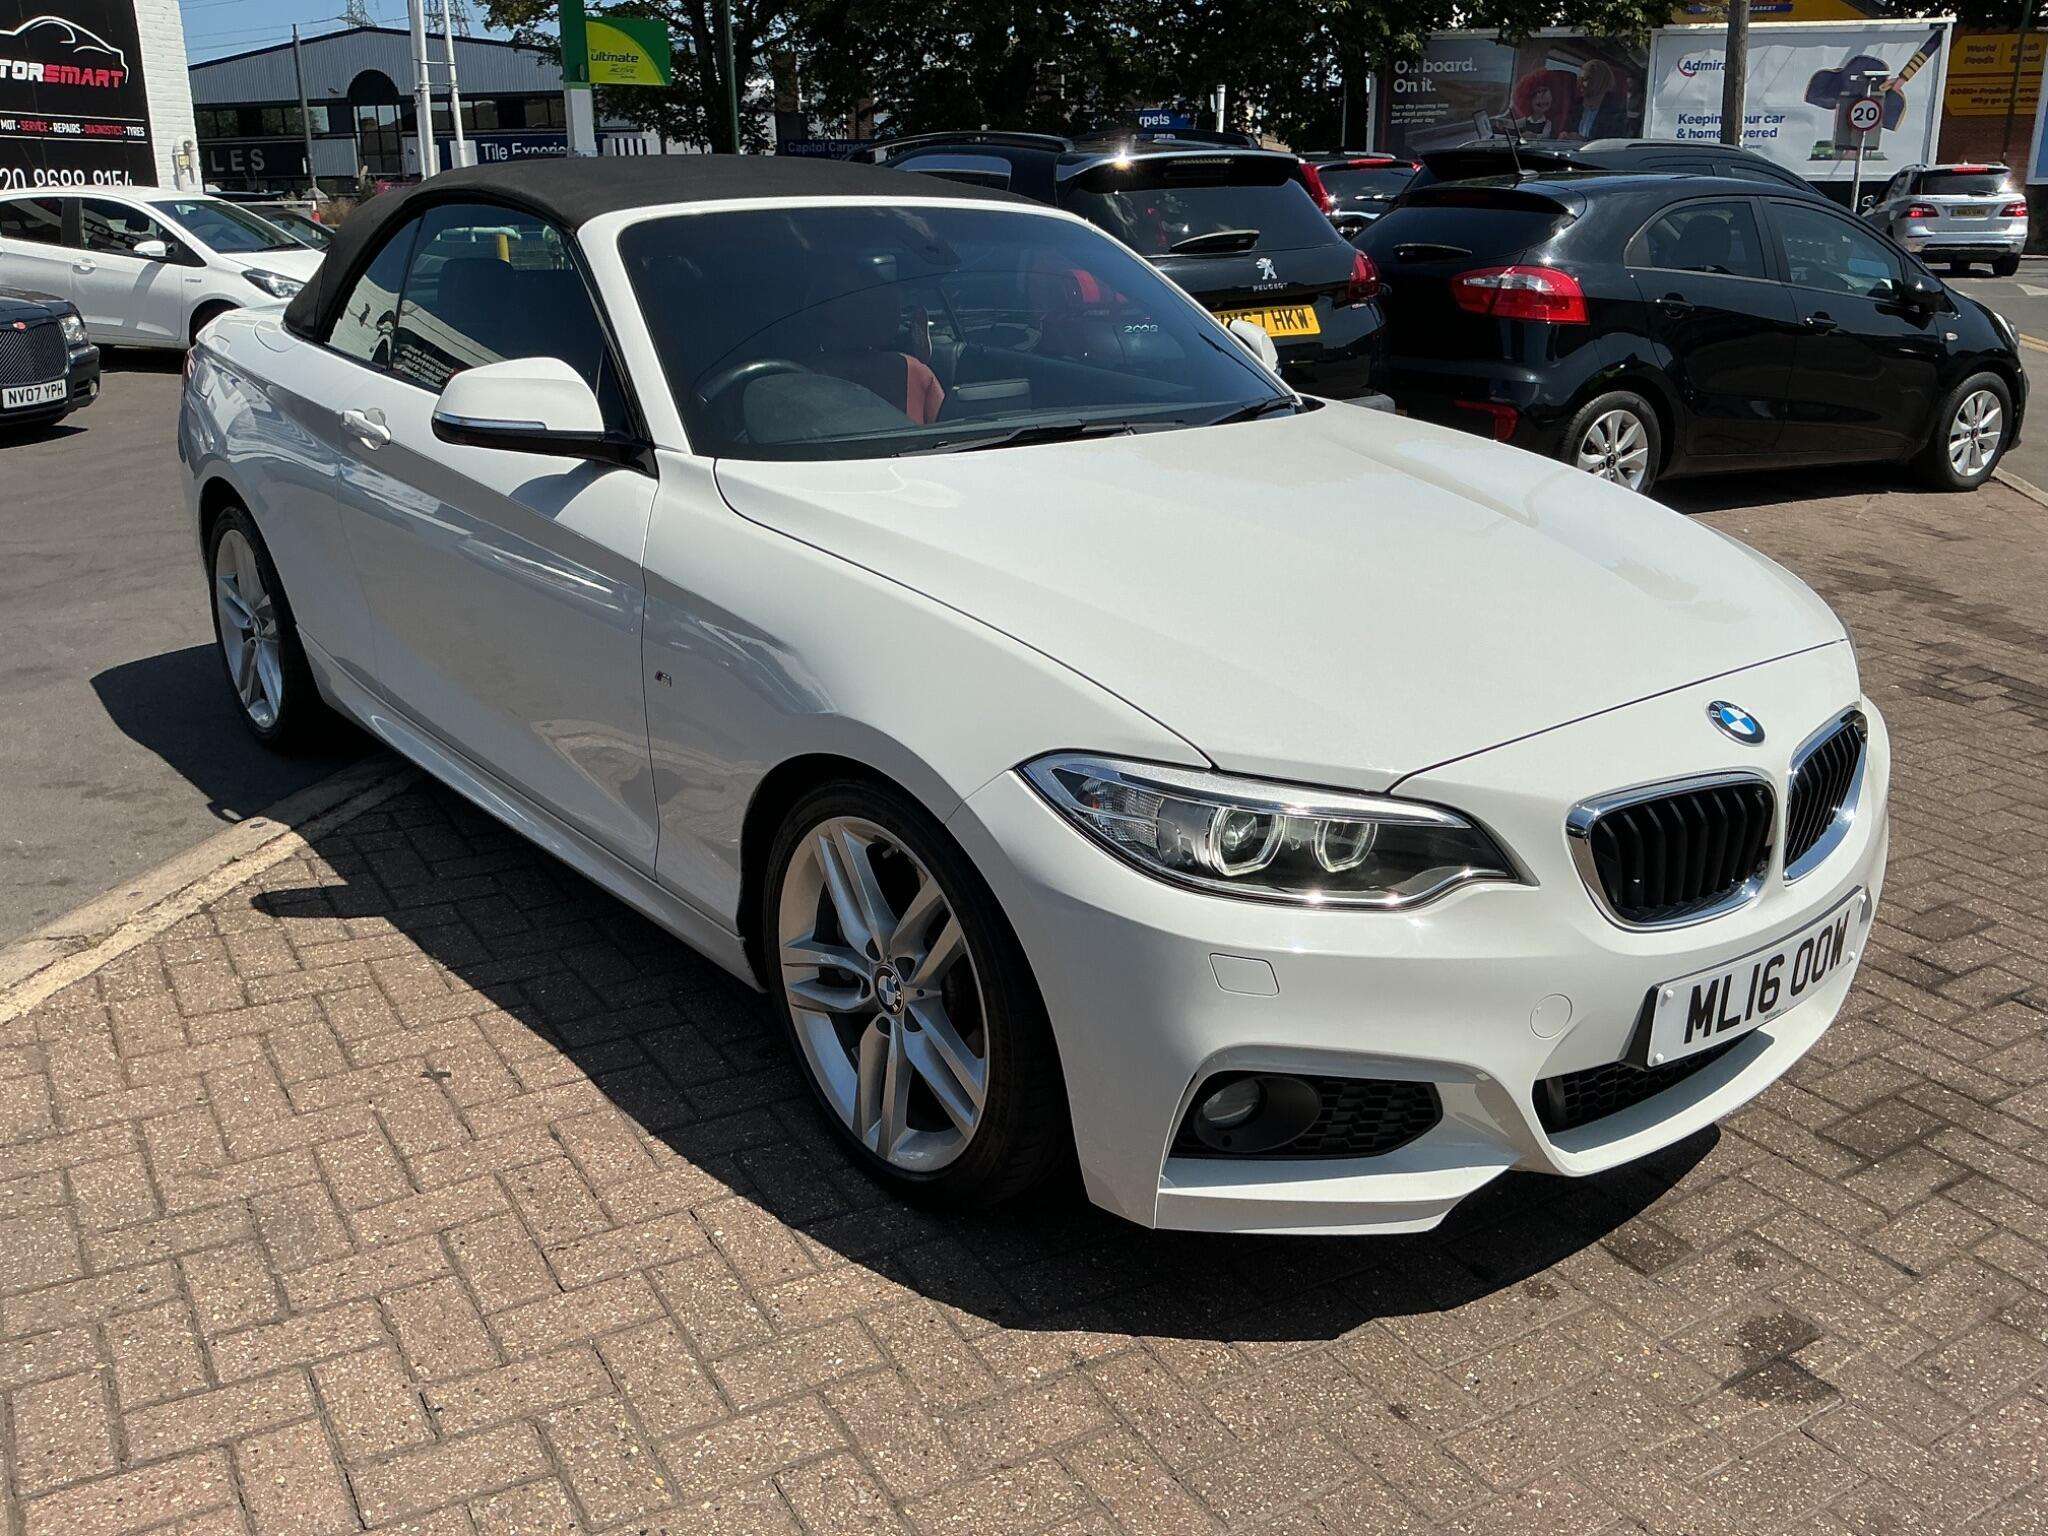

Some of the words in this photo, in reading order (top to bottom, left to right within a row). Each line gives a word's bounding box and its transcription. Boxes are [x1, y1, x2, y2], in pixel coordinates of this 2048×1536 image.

[590, 51, 640, 63] ultimate
[1422, 57, 1478, 73] board.
[1683, 59, 1727, 72] Admira
[1393, 78, 1418, 93] On
[1421, 77, 1437, 92] it.
[1138, 113, 1171, 128] rpets
[1678, 113, 1723, 127] Keepin
[1764, 114, 1786, 124] car
[1853, 107, 1877, 121] 20
[0, 119, 16, 131] MOT
[20, 120, 48, 132] SERVICE
[53, 122, 80, 134] REPAIRS
[84, 124, 123, 137] DIAGNOSTICS
[126, 126, 145, 137] TYRES
[1676, 128, 1686, 139] &
[1744, 127, 1778, 138] vered
[481, 143, 508, 160] Tile
[788, 142, 826, 154] Capitol
[1252, 282, 1288, 292] PEUGEOT
[1270, 307, 1309, 331] HKW
[8, 387, 41, 405] NV07
[45, 382, 63, 399] YPH
[1684, 952, 1786, 1045] ML16
